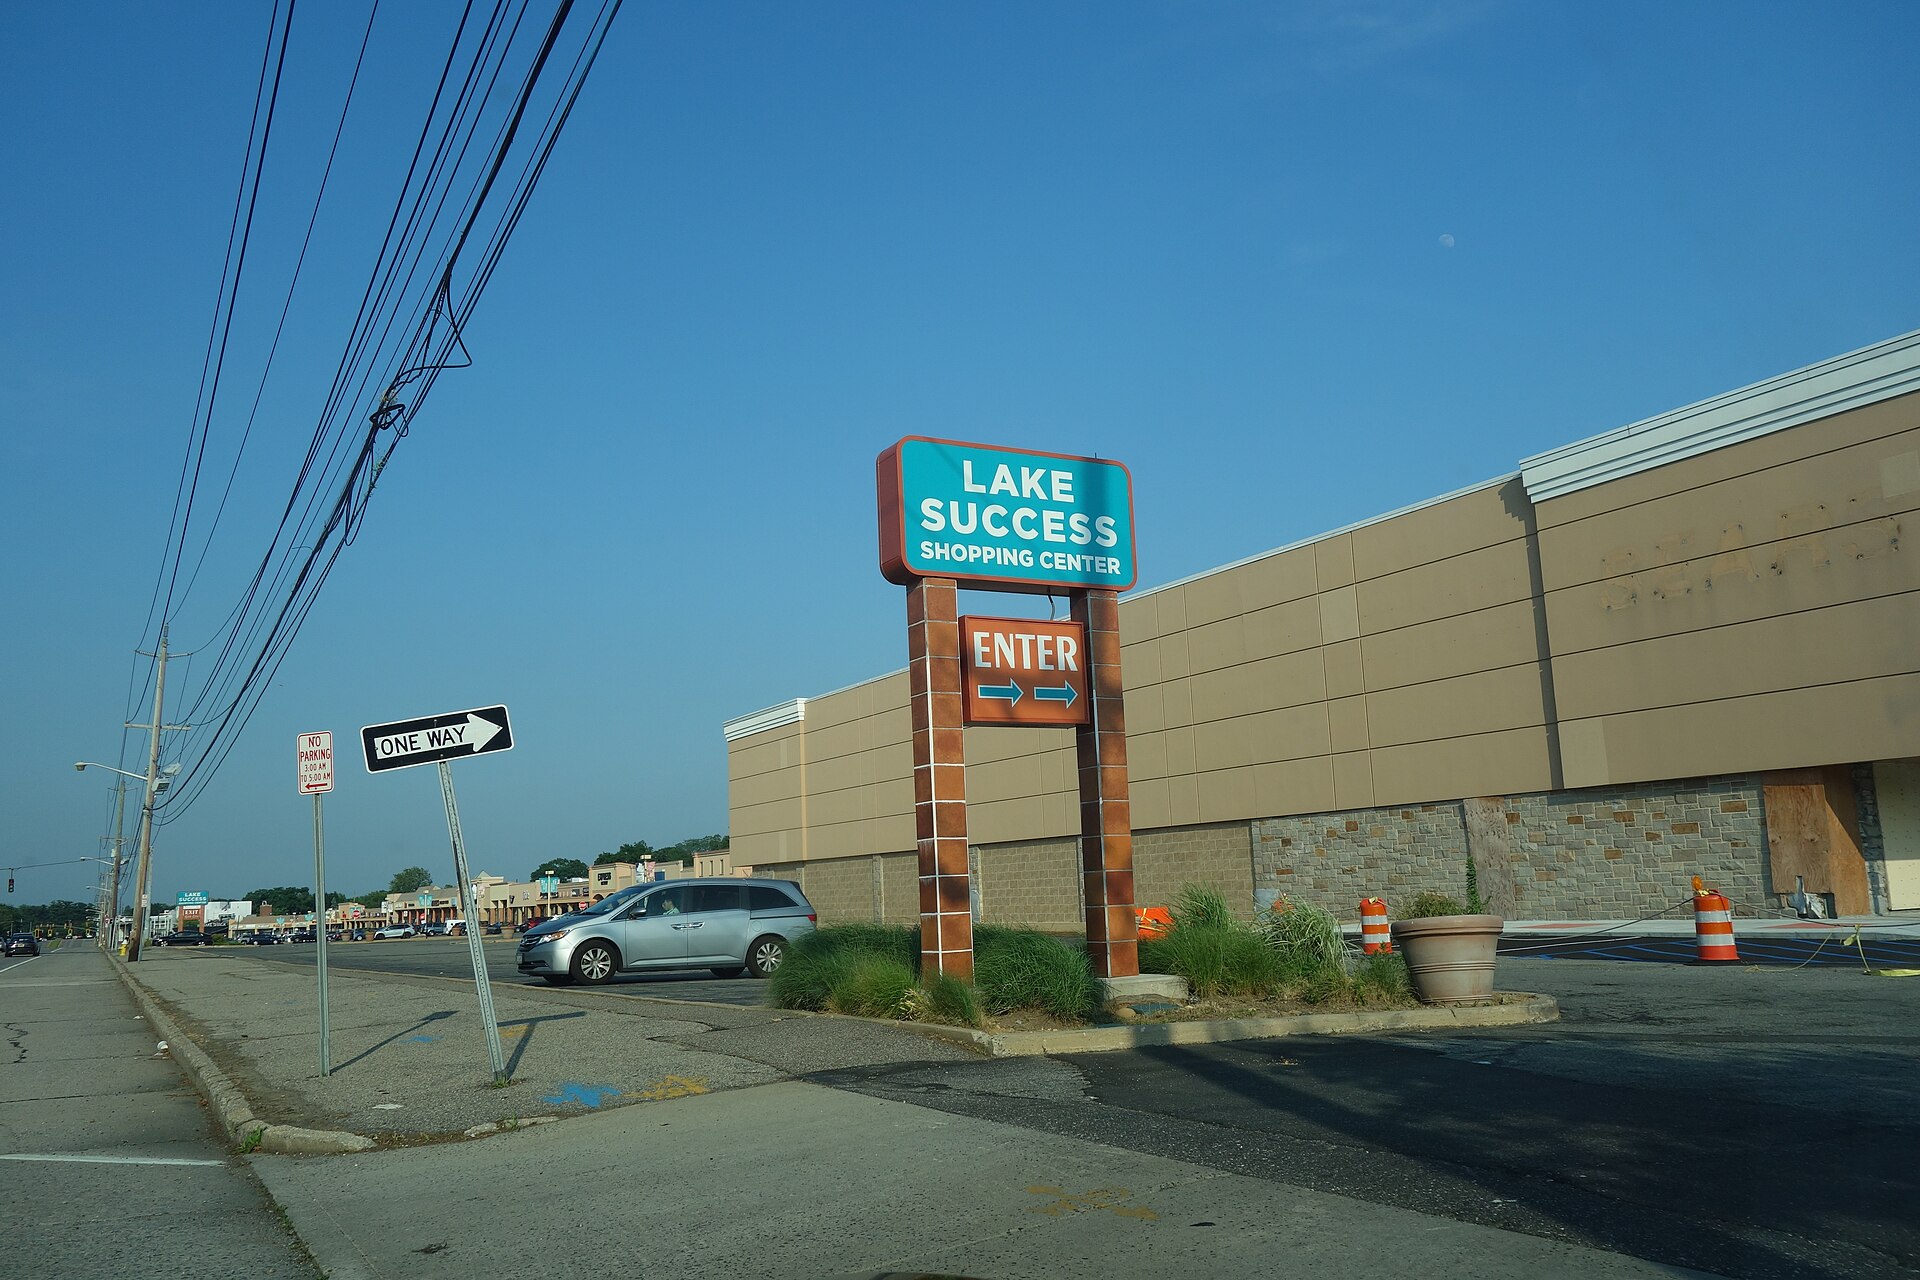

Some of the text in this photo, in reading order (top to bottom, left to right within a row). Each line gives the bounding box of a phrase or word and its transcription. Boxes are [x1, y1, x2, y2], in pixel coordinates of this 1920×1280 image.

[963, 459, 1075, 503] LAKE
[920, 498, 1118, 547] SUCCESS
[920, 541, 1121, 575] SHOPPING CENTER
[973, 631, 1078, 671] ENTER
[300, 748, 331, 762] PARKING
[308, 735, 321, 748] NO
[380, 725, 466, 756] ONE WAY
[300, 772, 331, 782] TO 5:00 AM
[304, 762, 327, 772] 3:00 AM
